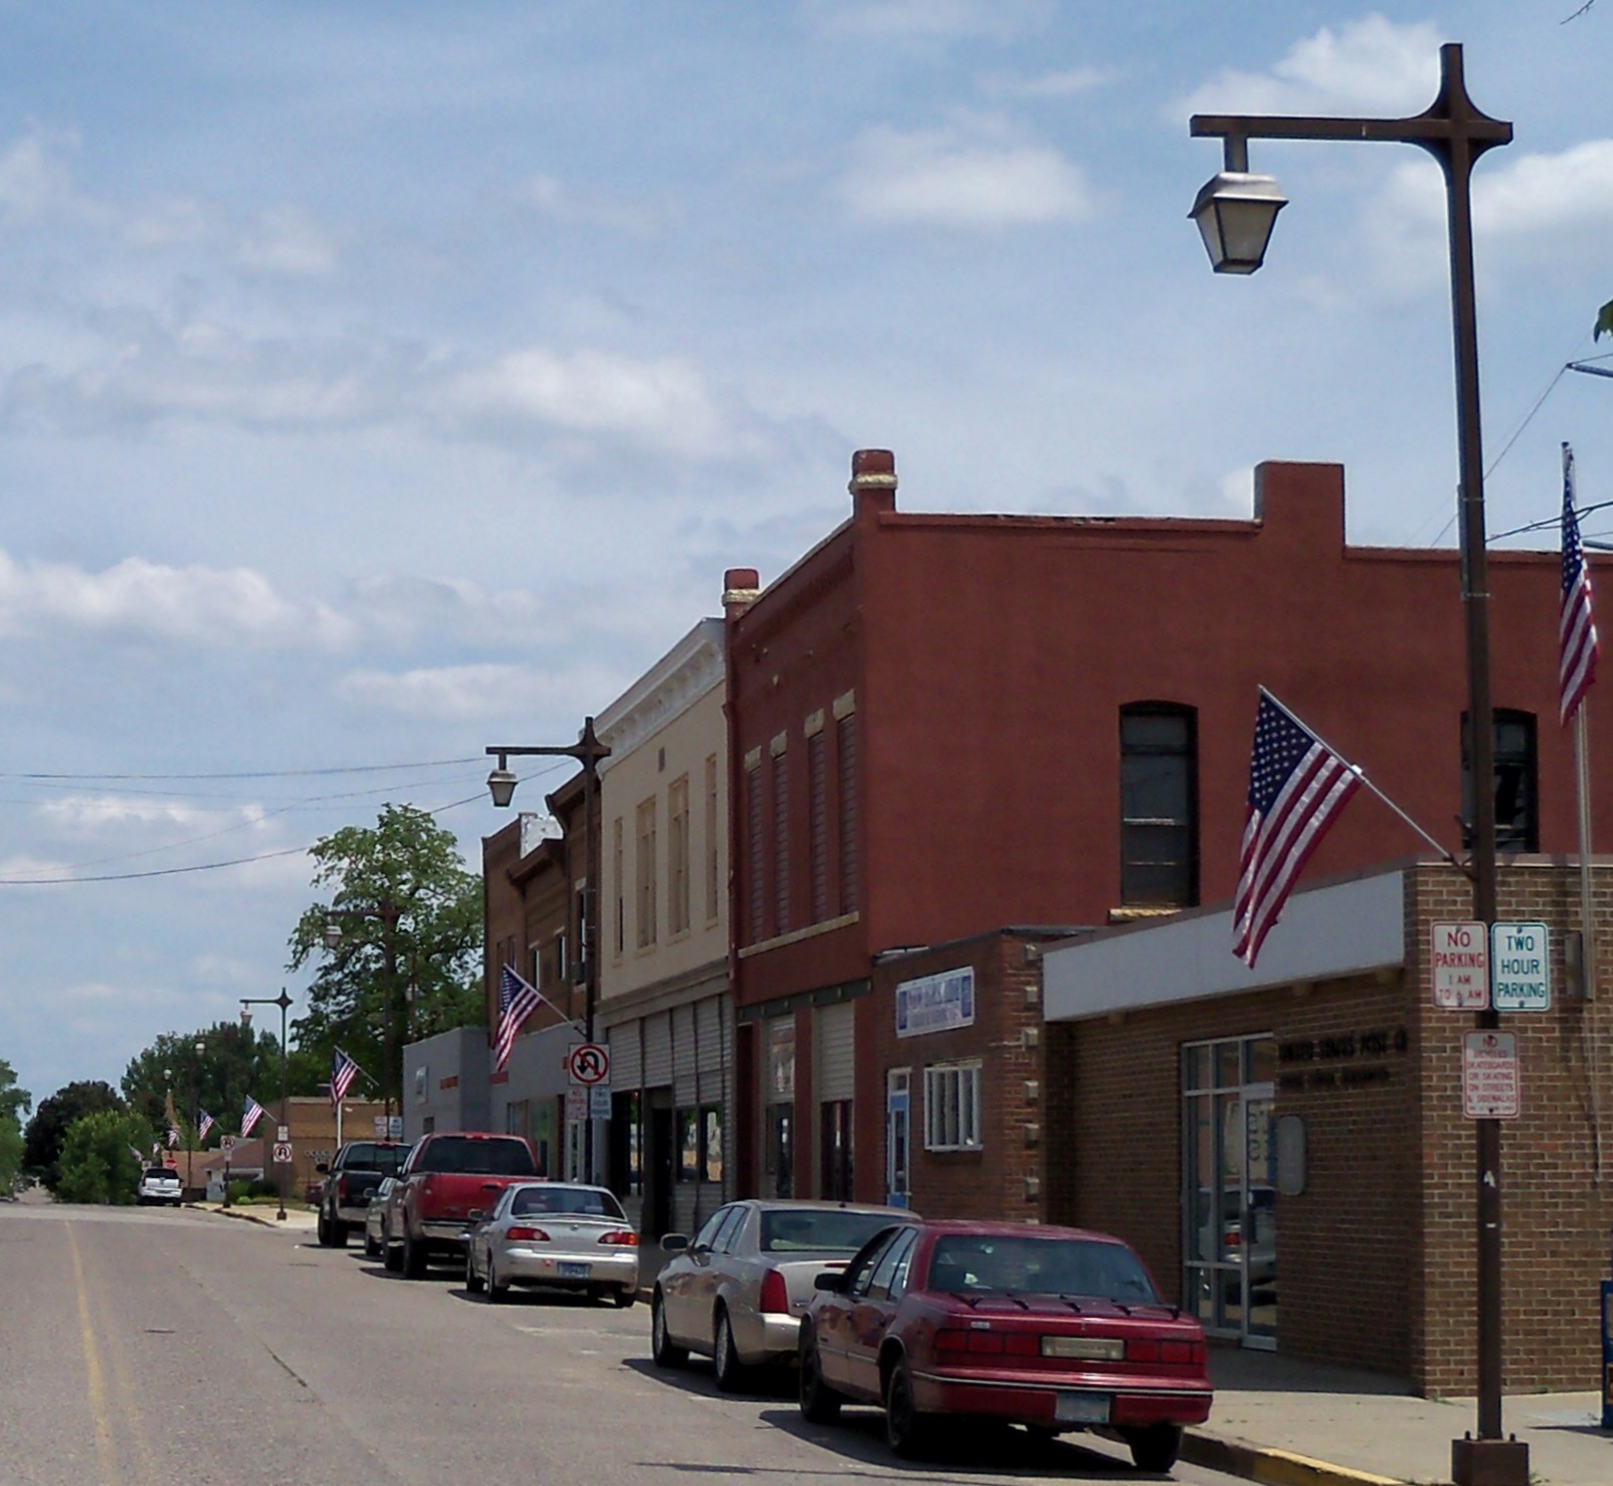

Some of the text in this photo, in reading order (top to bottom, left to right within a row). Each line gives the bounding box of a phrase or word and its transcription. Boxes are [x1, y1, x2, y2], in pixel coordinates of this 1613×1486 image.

[1447, 931, 1472, 948] NO
[1506, 935, 1535, 952] TWO
[1434, 952, 1484, 968] PARKING
[1501, 959, 1540, 975] HOUR
[1457, 975, 1471, 985] AM
[1439, 989, 1451, 1000] TO
[1468, 989, 1482, 999] AM
[1497, 982, 1545, 999] PARKING
[1483, 1036, 1498, 1048] NO
